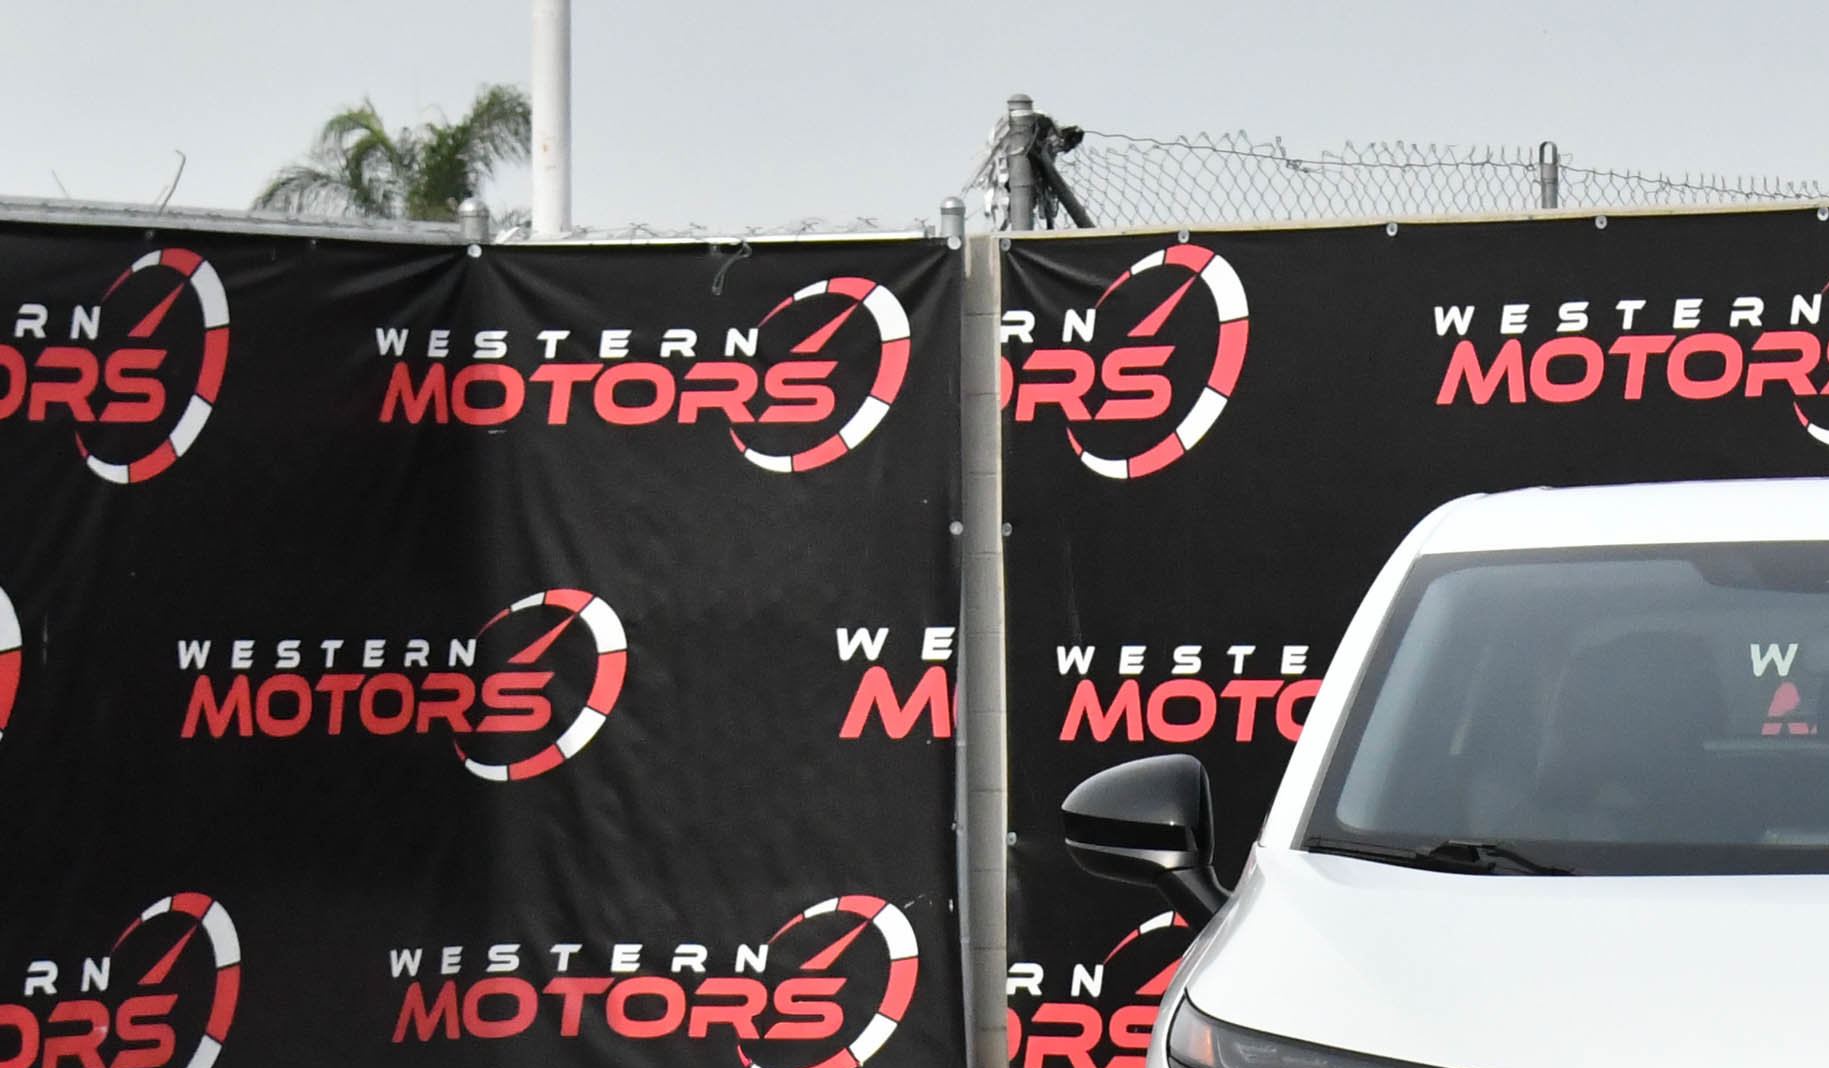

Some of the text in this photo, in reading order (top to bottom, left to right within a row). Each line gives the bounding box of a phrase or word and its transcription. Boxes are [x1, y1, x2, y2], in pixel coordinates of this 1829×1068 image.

[1433, 293, 1823, 337] WESTERN
[375, 327, 759, 360] WESTERN
[379, 359, 839, 427] MOTORS
[1000, 344, 1177, 423] RS
[178, 638, 477, 670] WESTERN
[180, 671, 556, 739] MOTORS
[390, 943, 769, 978] WESTERN
[392, 975, 848, 1043] MOTORS
